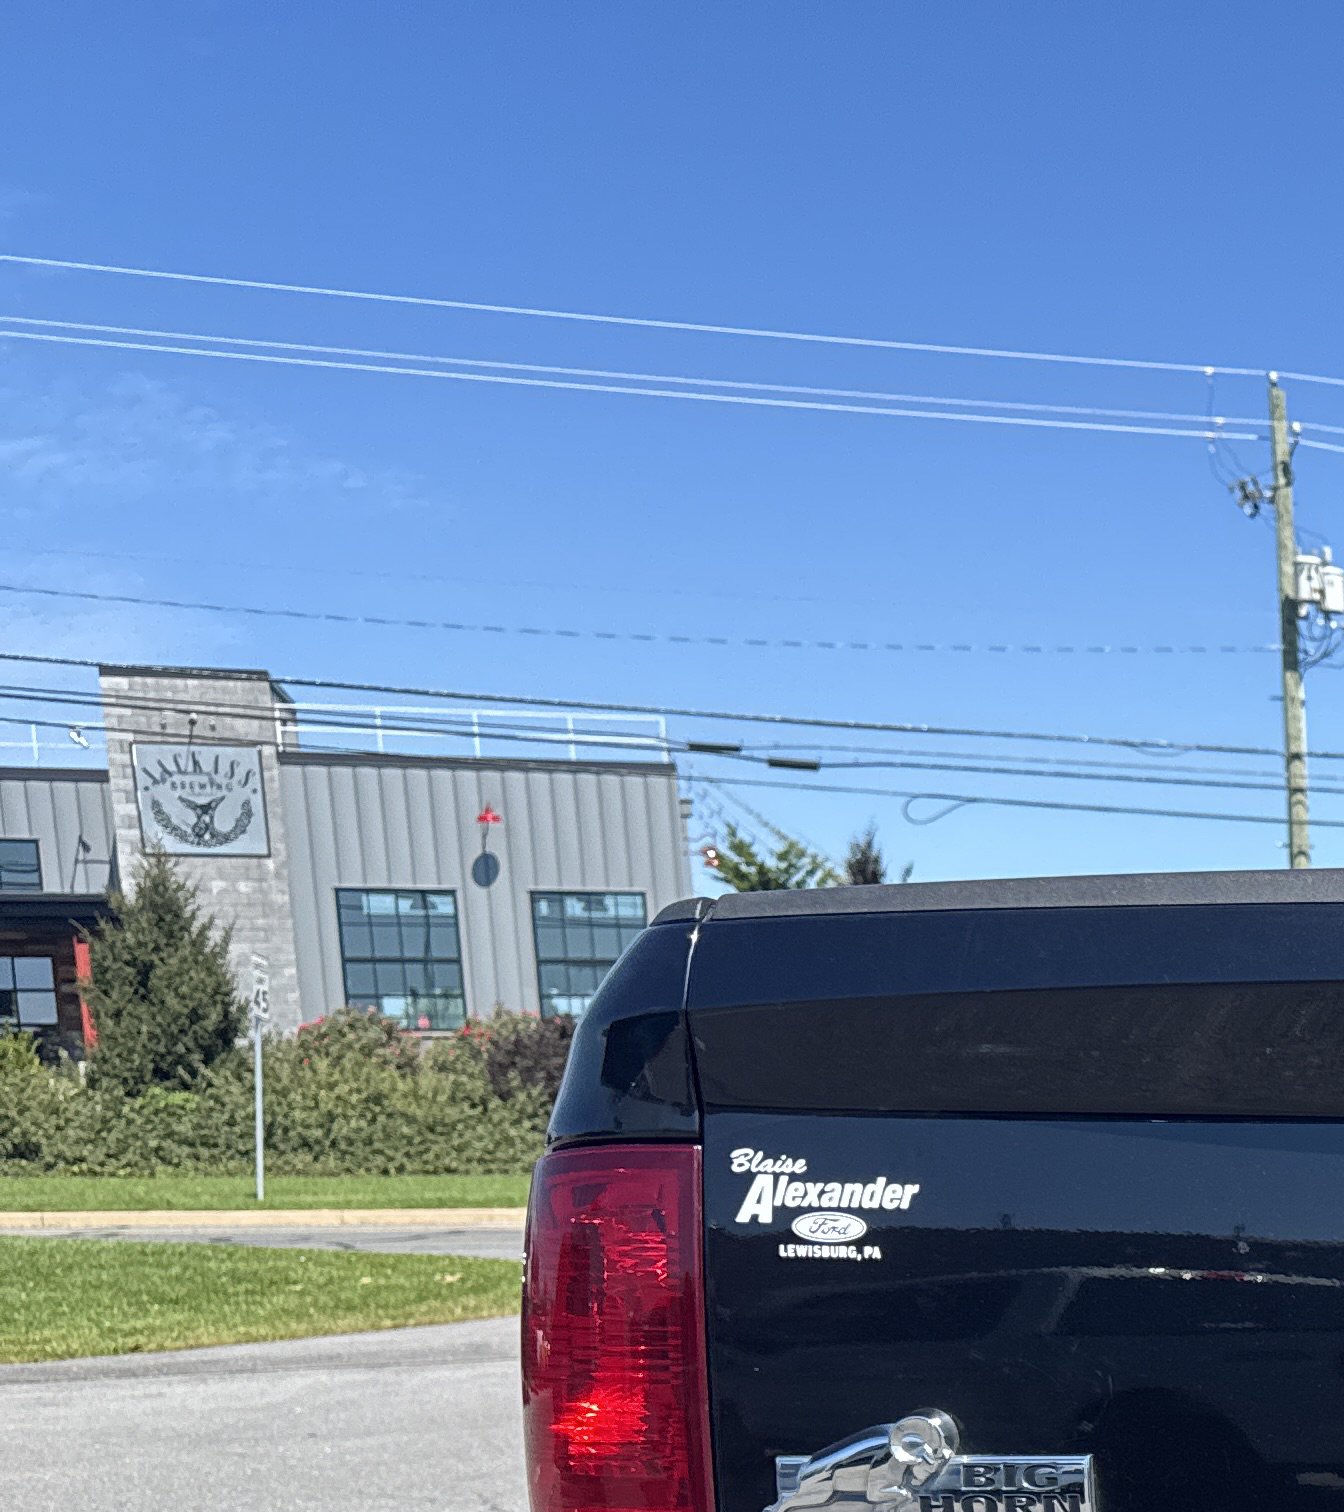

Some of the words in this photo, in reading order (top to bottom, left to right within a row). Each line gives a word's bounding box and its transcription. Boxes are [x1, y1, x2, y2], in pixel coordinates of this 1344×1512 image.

[730, 1148, 808, 1174] Blaise
[734, 1174, 920, 1224] Alexander
[808, 1217, 852, 1236] Ford
[778, 1244, 862, 1261] LEWISBURG,
[863, 1245, 882, 1259] PA
[961, 1463, 1059, 1491] BIG
